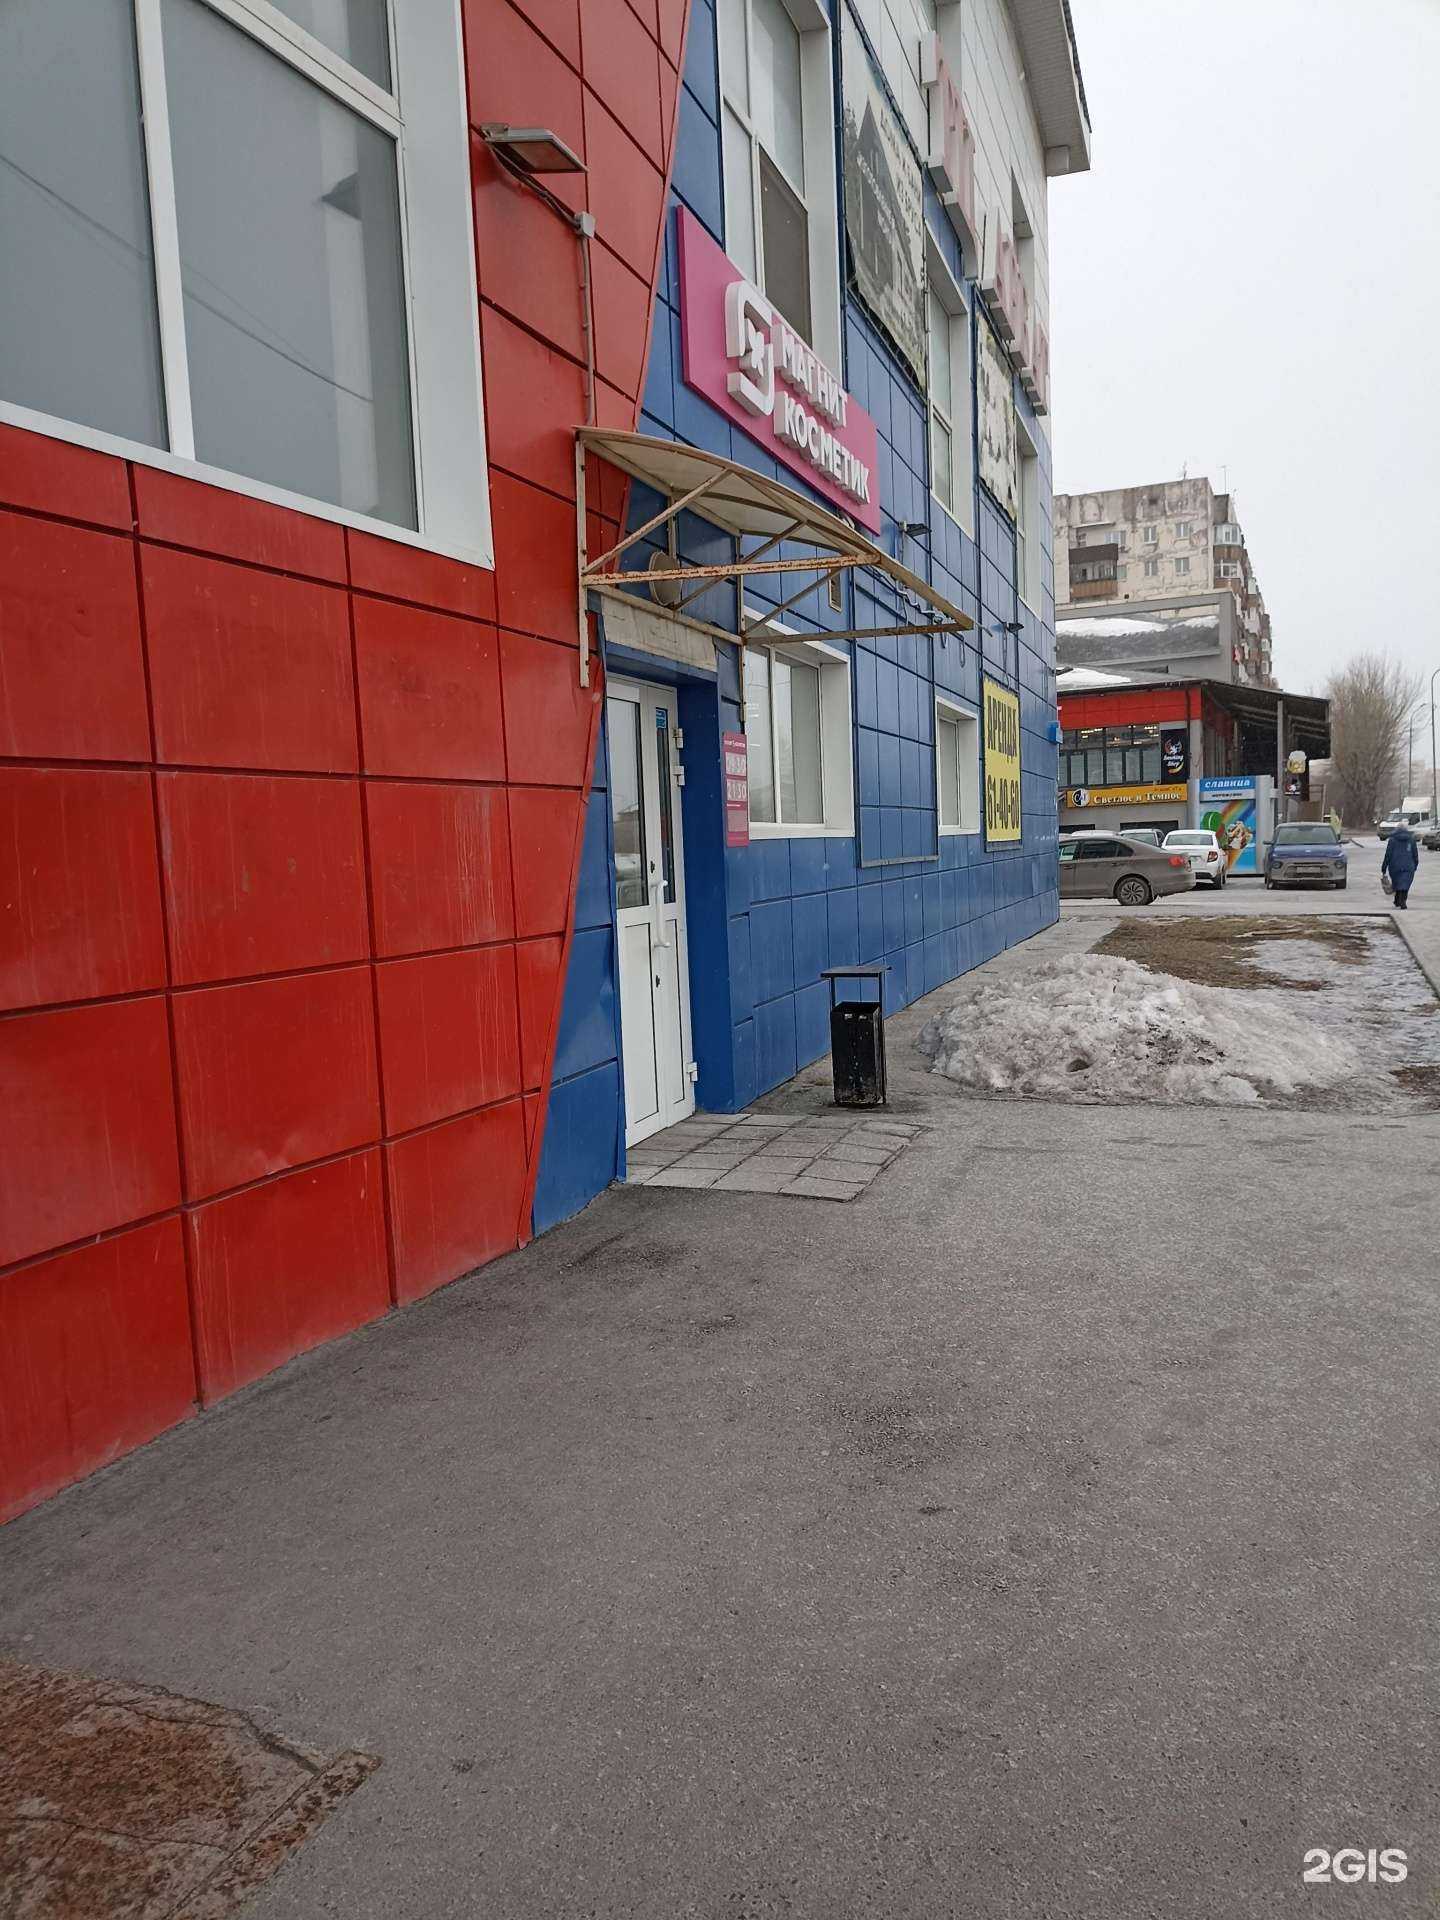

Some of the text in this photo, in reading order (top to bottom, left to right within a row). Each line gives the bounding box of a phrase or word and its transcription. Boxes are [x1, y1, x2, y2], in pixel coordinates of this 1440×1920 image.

[775, 323, 848, 428] МАГНИТ
[775, 391, 871, 504] КОСМЕТИК
[987, 695, 1018, 764] АРЕНДА
[1093, 795, 1132, 804] Светлое
